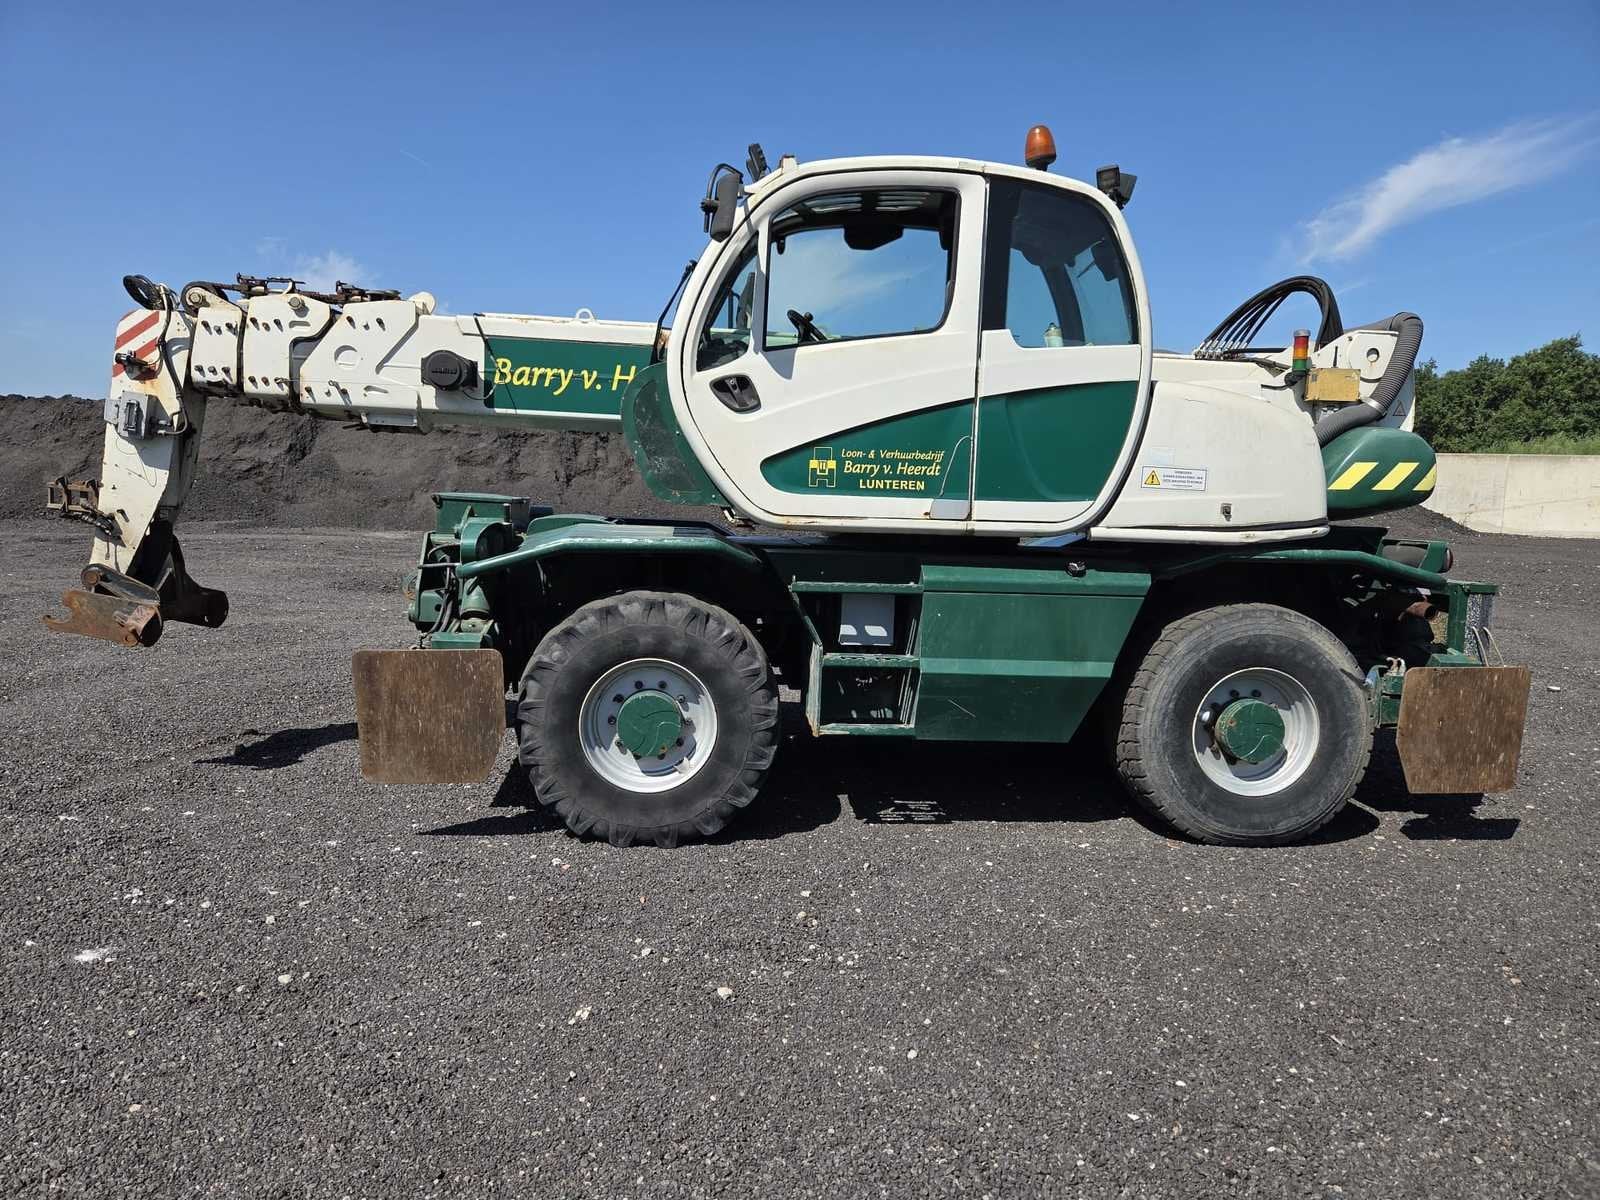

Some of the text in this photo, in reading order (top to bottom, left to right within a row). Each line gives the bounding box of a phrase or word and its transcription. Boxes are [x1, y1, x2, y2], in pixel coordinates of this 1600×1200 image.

[494, 358, 572, 396] Barry
[582, 369, 602, 390] v.
[841, 448, 944, 463] Loon- & Verhuurbedrijf
[844, 460, 941, 477] Barry v. Heerdt
[859, 479, 925, 490] LUNTEREN
